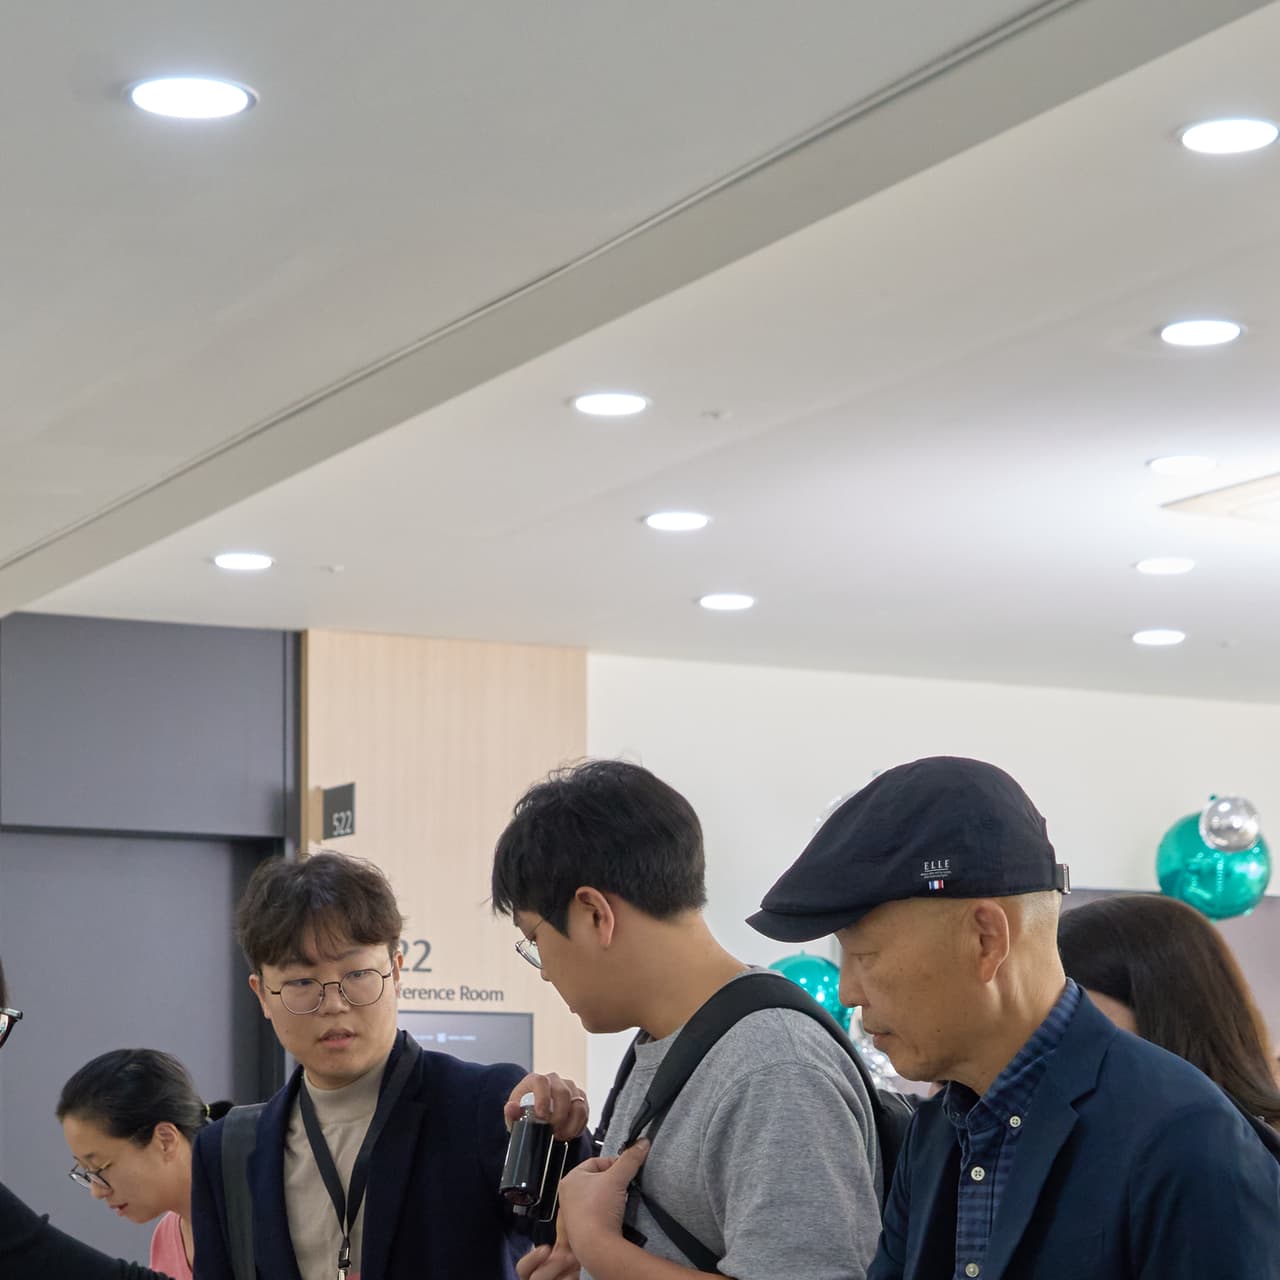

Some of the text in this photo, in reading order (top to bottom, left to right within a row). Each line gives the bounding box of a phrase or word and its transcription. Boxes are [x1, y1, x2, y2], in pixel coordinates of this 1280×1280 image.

[332, 810, 352, 836] 522
[923, 859, 950, 872] ELLE
[400, 939, 433, 973] 22
[401, 984, 504, 1002] erence Room
